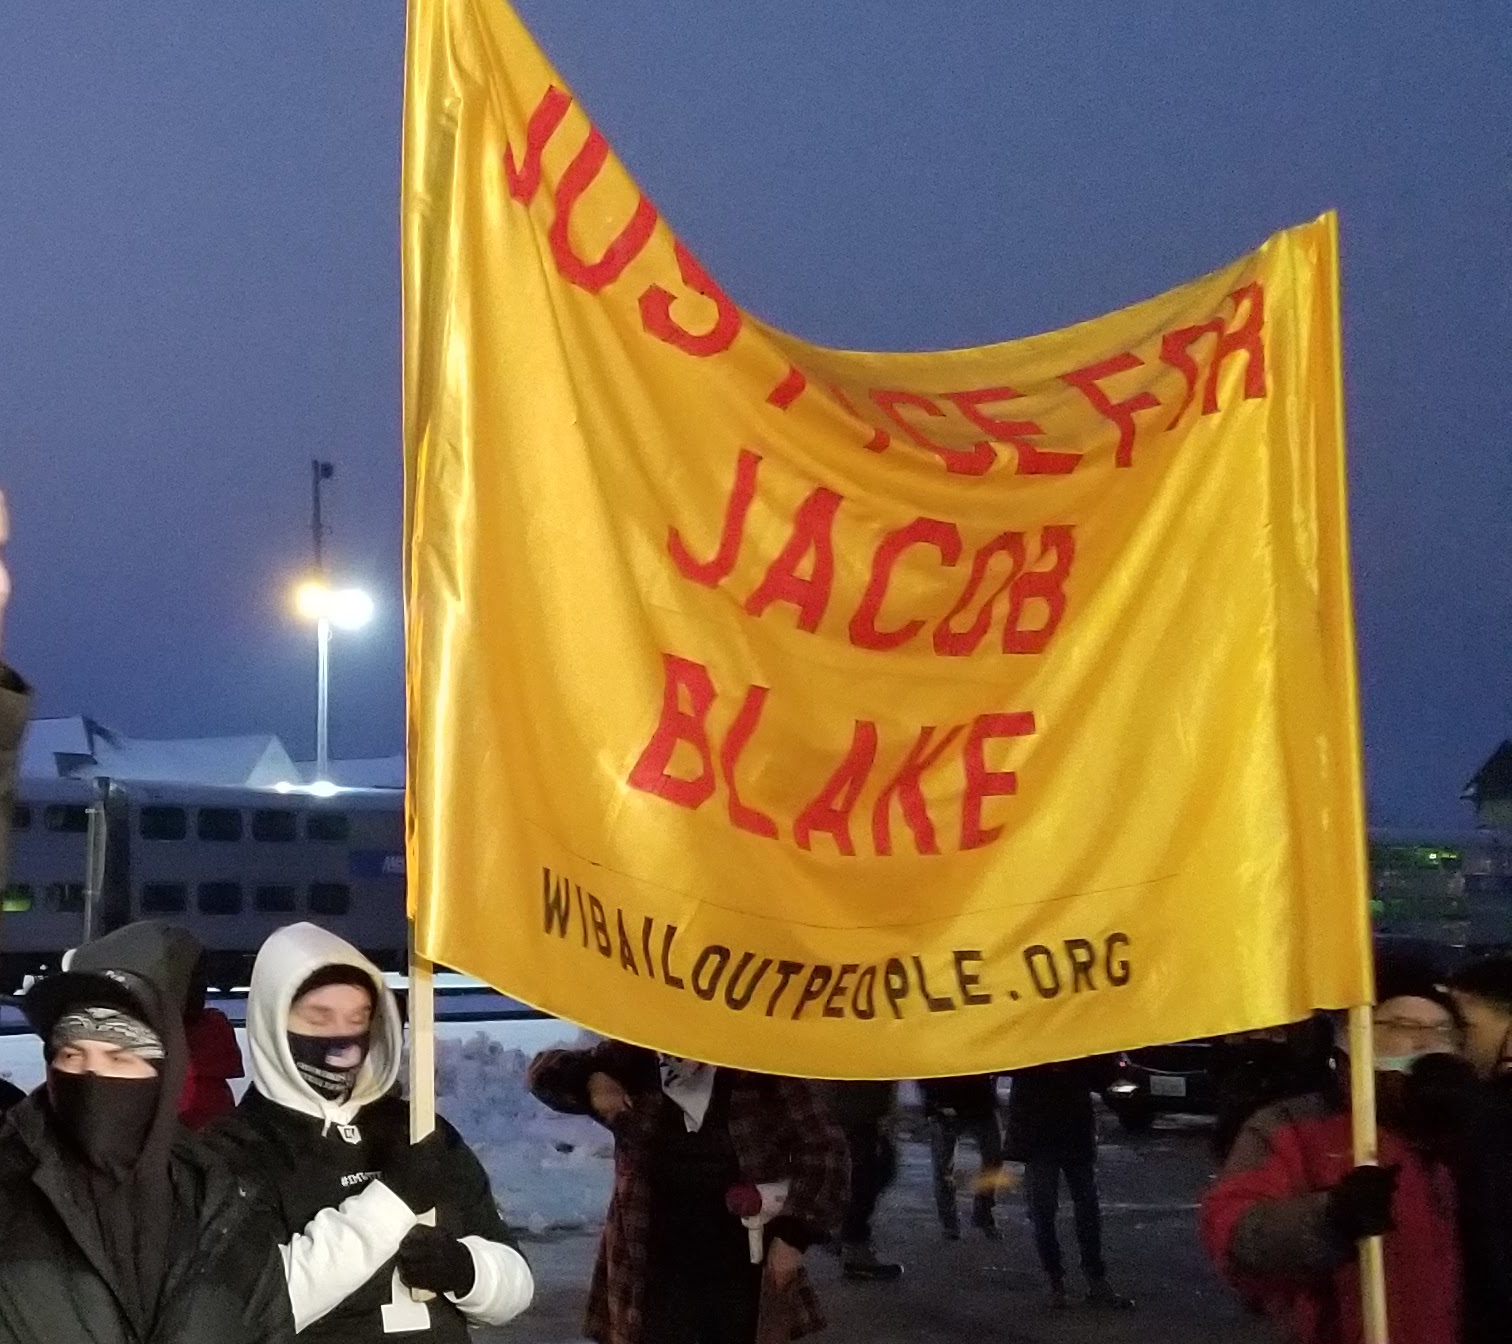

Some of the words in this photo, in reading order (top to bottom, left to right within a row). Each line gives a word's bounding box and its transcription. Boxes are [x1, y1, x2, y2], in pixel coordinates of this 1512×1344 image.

[668, 448, 1076, 656] JACOB
[627, 652, 1036, 856] BLAKE
[541, 866, 1131, 1020] WIBAILOUTPEOPLE.ORG
